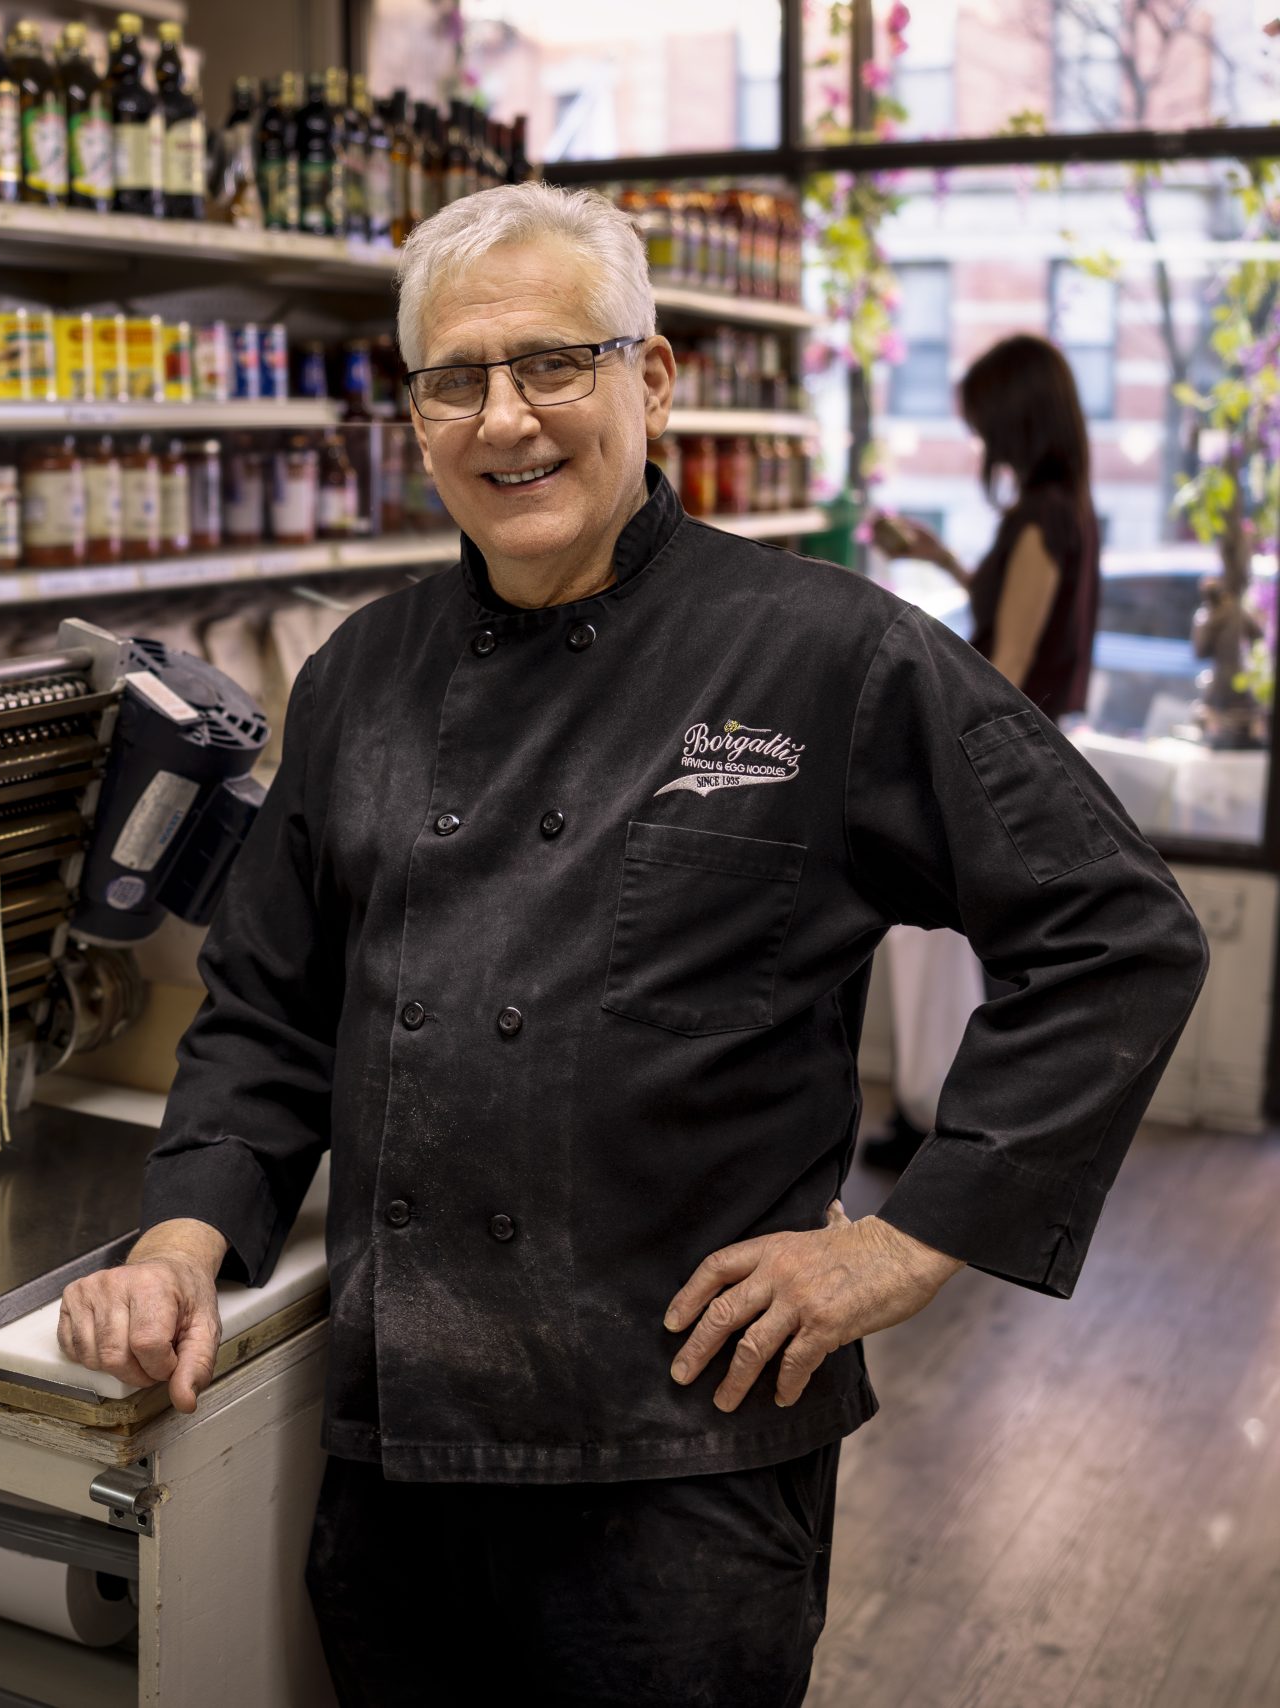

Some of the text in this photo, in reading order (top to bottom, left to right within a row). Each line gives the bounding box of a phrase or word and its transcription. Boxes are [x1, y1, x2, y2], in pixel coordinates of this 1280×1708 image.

[683, 723, 805, 767] Borgatti's
[681, 757, 714, 770] RAVIOLI
[724, 763, 746, 773] EGG
[746, 765, 786, 776] NOODLES
[696, 775, 741, 788] SINCE 1935
